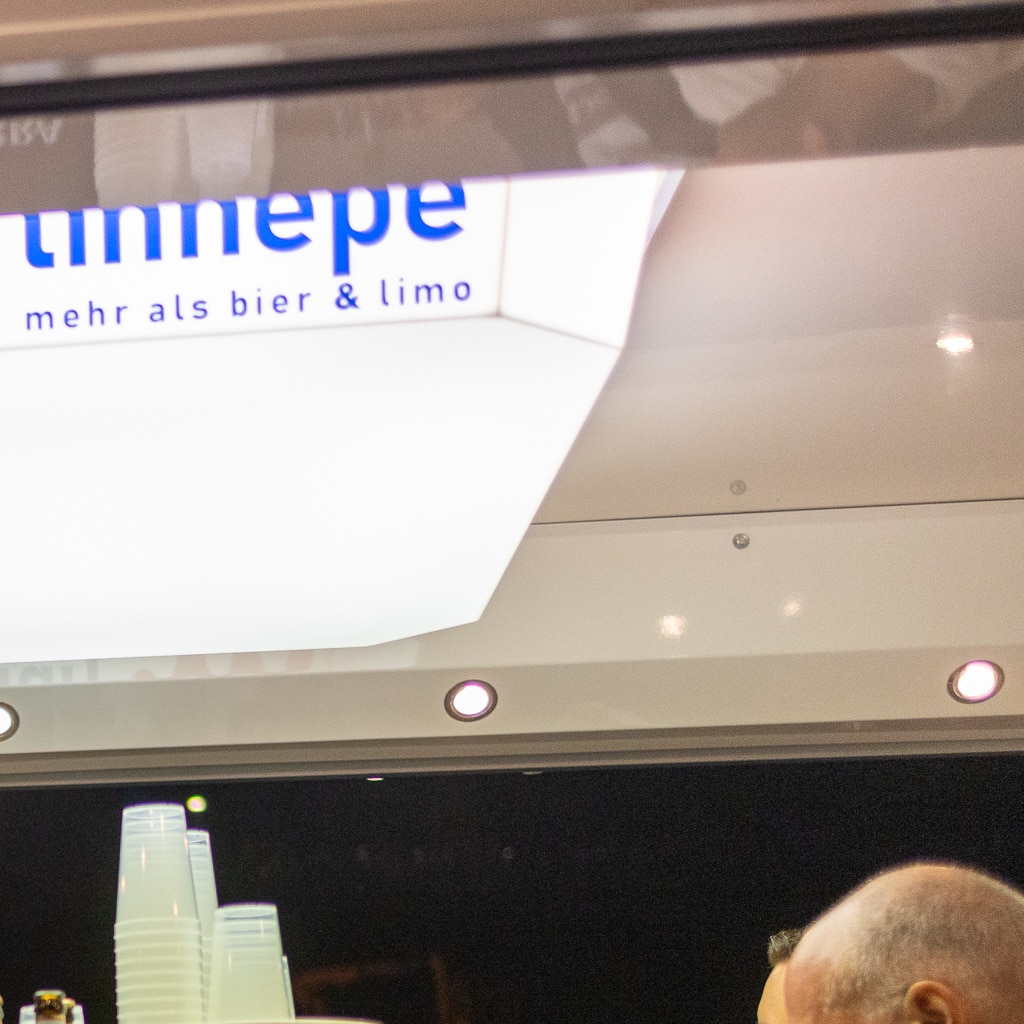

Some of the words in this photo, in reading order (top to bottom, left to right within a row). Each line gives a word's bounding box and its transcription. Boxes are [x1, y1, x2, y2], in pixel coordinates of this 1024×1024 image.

[26, 300, 128, 331] mehr
[149, 293, 209, 323] als
[231, 288, 311, 317] bier
[334, 282, 360, 311] &
[381, 277, 472, 306] limo
